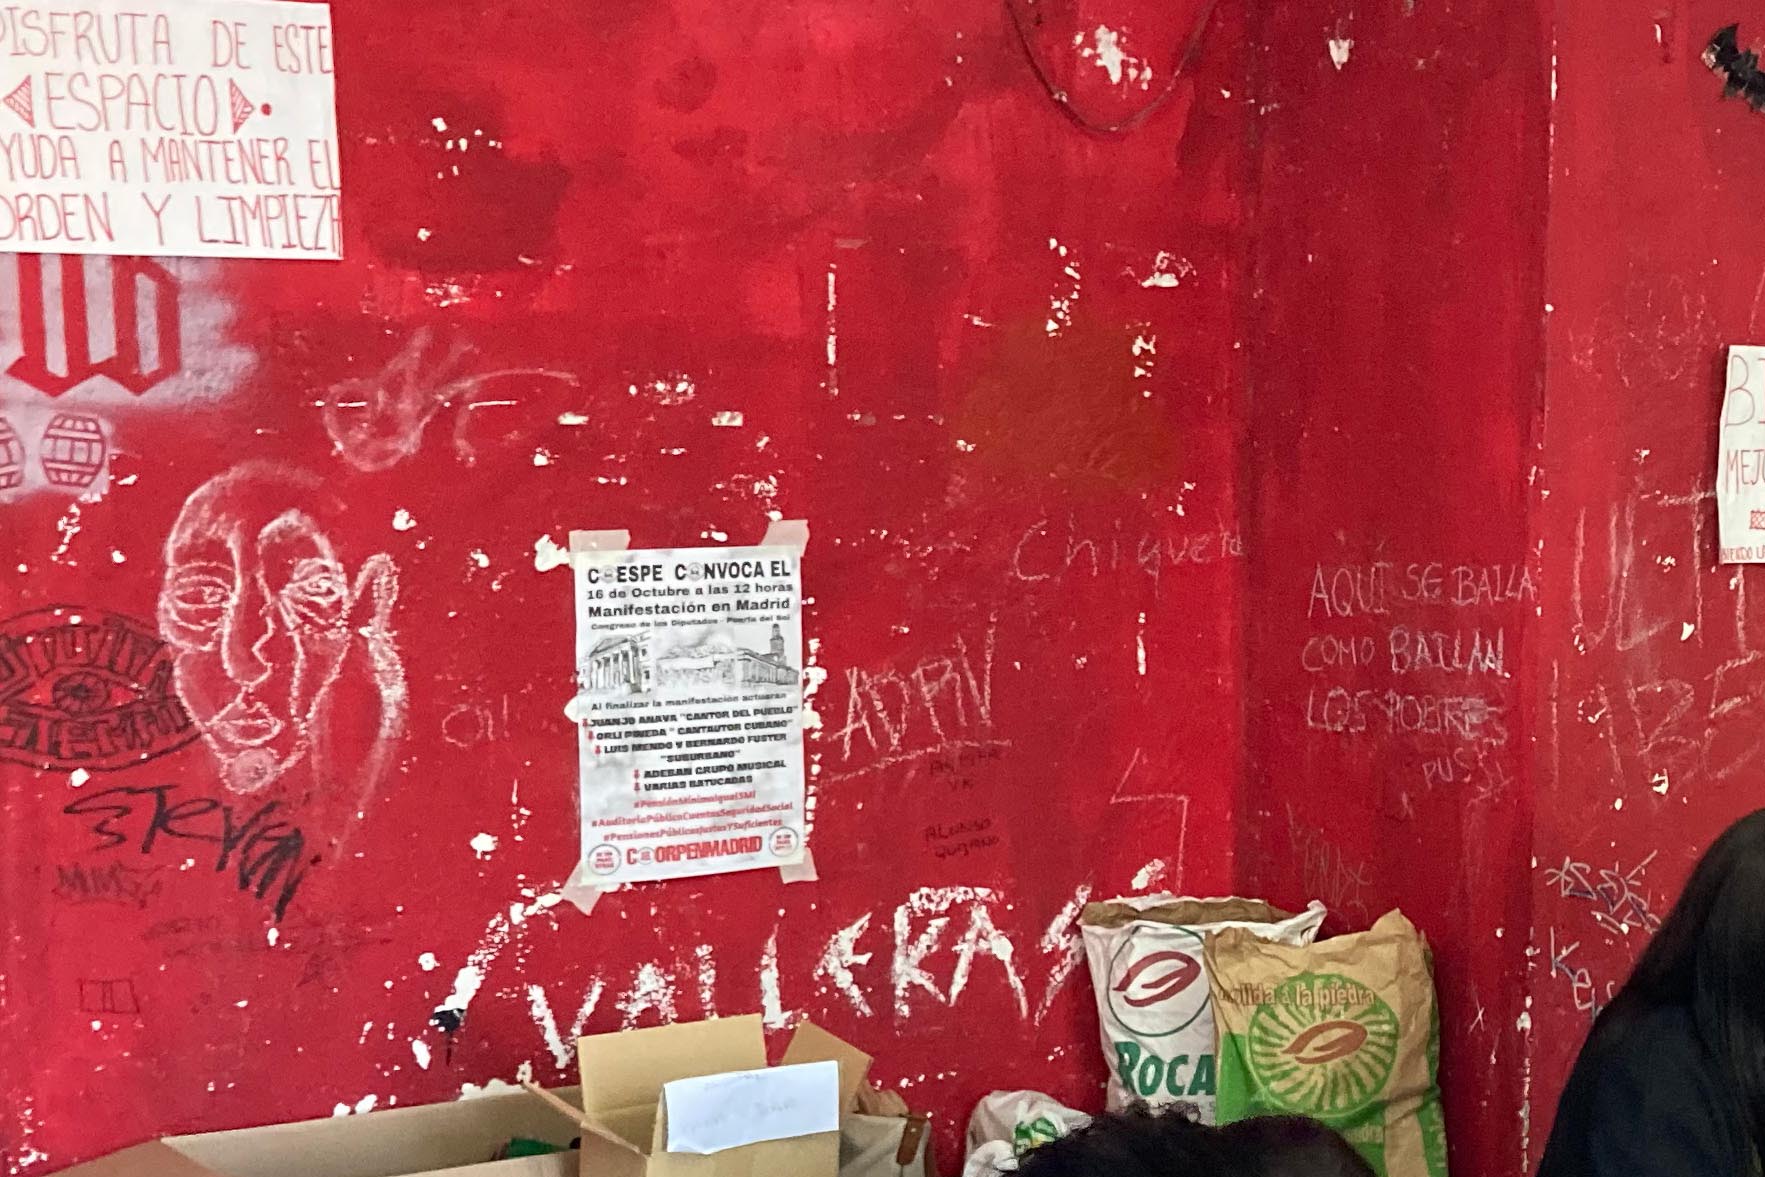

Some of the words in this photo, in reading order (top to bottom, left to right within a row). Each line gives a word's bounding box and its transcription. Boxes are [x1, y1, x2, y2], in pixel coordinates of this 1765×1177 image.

[211, 20, 251, 69] DE
[273, 24, 333, 74] ESTE
[45, 72, 219, 136] ESPACIO
[108, 139, 128, 183] A
[140, 136, 296, 186] MANTENER
[308, 139, 342, 190] EL
[141, 192, 172, 246] Y
[771, 560, 791, 577] EL
[1401, 561, 1441, 601] SE
[1456, 562, 1536, 604] BAILA
[587, 589, 604, 600] 16
[609, 588, 627, 598] de
[631, 586, 690, 598] Octubre
[695, 587, 703, 595] a
[708, 584, 729, 594] las
[734, 583, 750, 593] 12
[755, 583, 793, 592] horas
[588, 602, 706, 617] Manifestación
[711, 602, 731, 612] en
[736, 598, 790, 611] Madrid
[1302, 633, 1376, 674] COMO
[1389, 625, 1510, 677] BAILAN
[606, 701, 649, 710] finalizar
[652, 699, 662, 707] la
[665, 696, 739, 706] manifestación
[1307, 687, 1366, 733] LOS
[644, 781, 687, 791] VARIAS
[736, 760, 787, 771] MUSICAL
